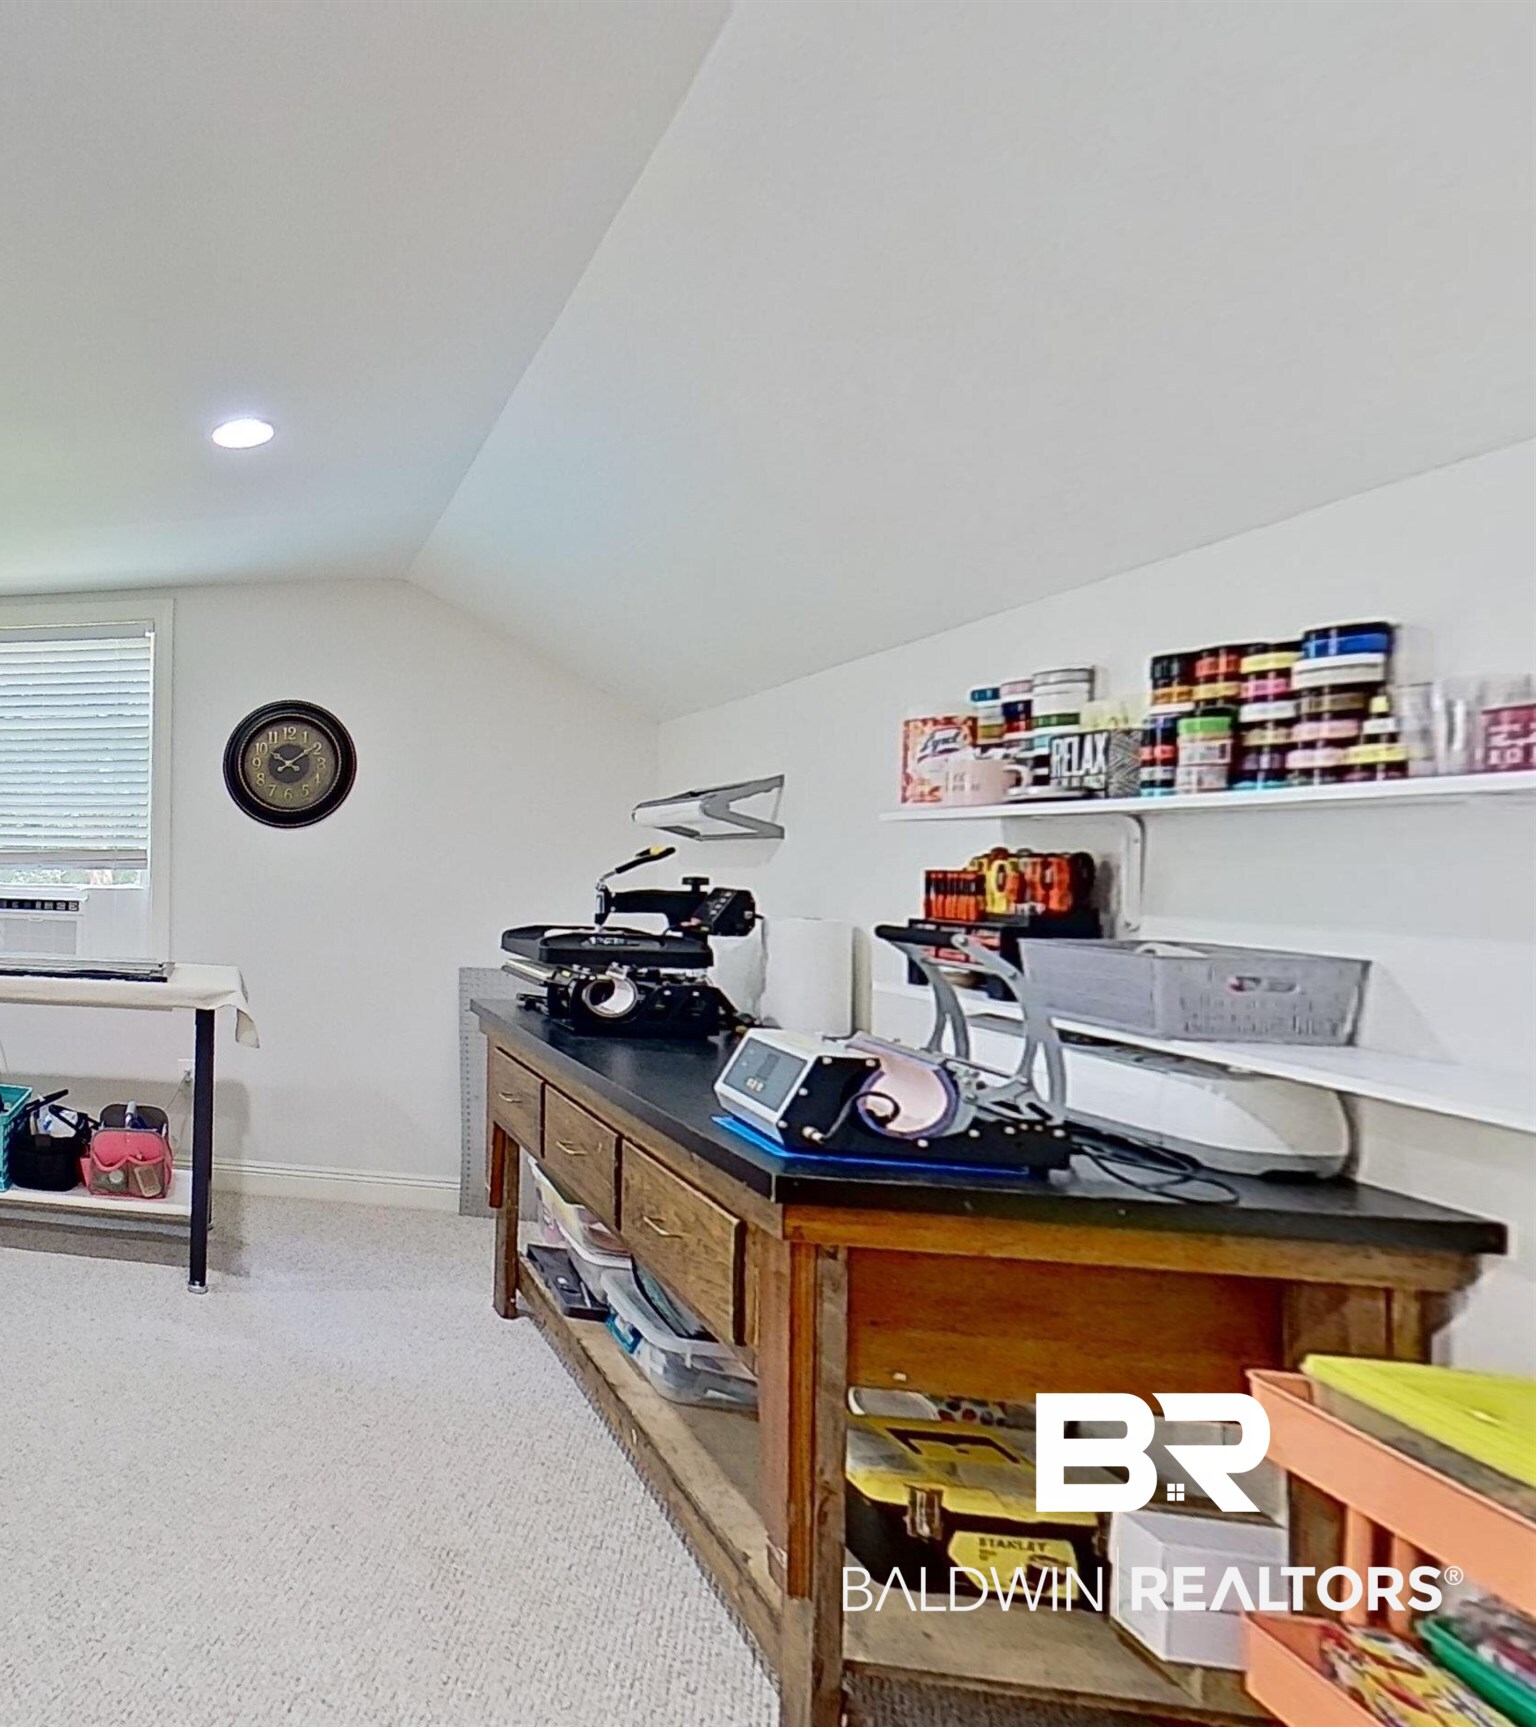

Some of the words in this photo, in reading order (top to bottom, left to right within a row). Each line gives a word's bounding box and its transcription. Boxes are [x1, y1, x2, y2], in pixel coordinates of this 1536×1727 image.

[268, 731, 278, 744] 11
[282, 726, 297, 740] 12
[255, 742, 268, 755] 10
[313, 741, 322, 755] 2
[1050, 731, 1109, 778] RELAX
[252, 757, 261, 770] 9
[256, 773, 265, 786] 8
[268, 784, 276, 797] 7
[284, 788, 293, 801] 6
[302, 784, 309, 797] 5
